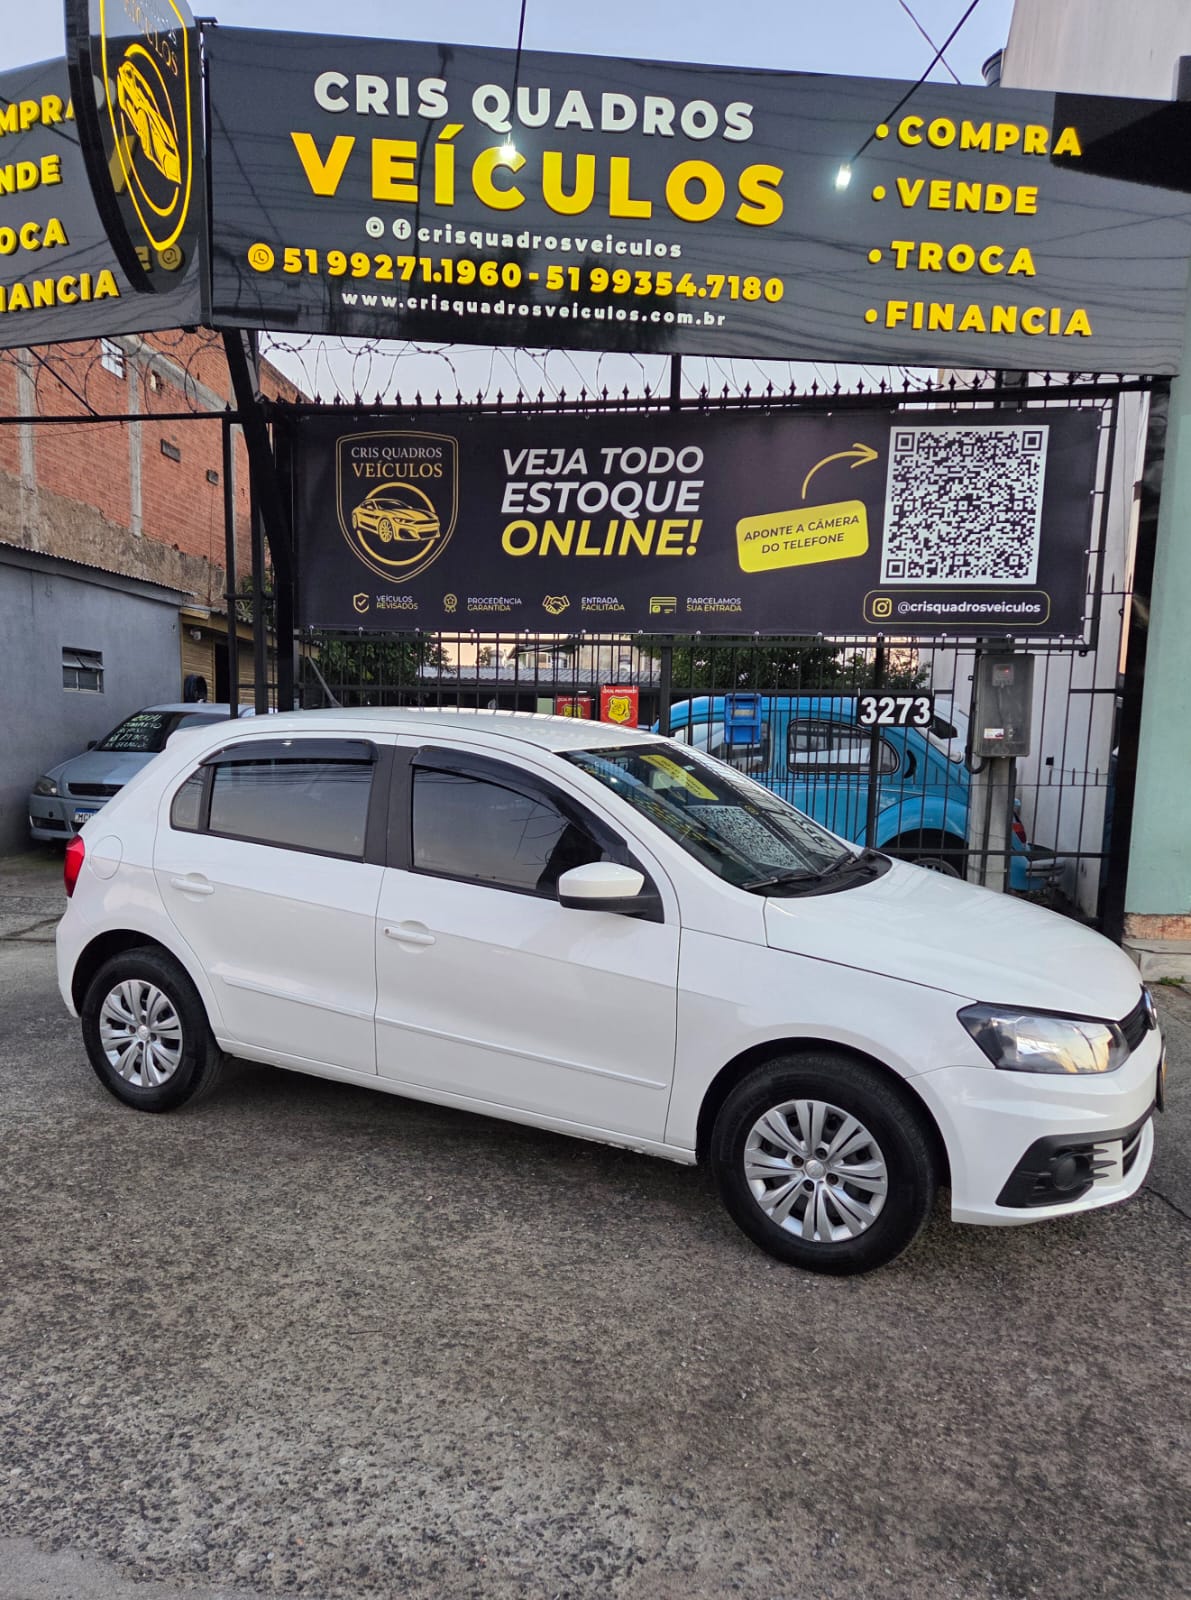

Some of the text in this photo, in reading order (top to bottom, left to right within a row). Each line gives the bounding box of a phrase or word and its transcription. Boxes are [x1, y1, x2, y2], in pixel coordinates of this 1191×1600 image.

[314, 71, 754, 142] CRIS QUADROS
[897, 115, 1082, 157] COMPRA
[290, 123, 784, 226] VEÍCULOS
[896, 177, 1039, 215] VENDE
[417, 223, 682, 258] crisquadrosveiculos
[891, 240, 1037, 276] TROCA
[341, 292, 726, 326] www.crisquadrosveiculos.com.br
[885, 300, 1093, 336] FINANCIA
[351, 447, 442, 460] CRIS QUADROS
[503, 445, 704, 476] VEJA TODO
[352, 460, 443, 478] VEÍCULOS
[501, 480, 705, 519] ESTOQUE
[501, 519, 704, 556] ONLINE!
[744, 515, 860, 542] APONTE A CÂMERA
[761, 532, 844, 554] DO TELEFONE
[376, 594, 413, 603] VEÍCULOS
[376, 602, 418, 610] REVISADOS
[467, 595, 522, 605] PROCEDÊNCIA
[467, 604, 511, 612] GARANTIDA
[581, 596, 619, 604] ENTRADA
[686, 597, 742, 605] PARCELAMOS
[686, 604, 742, 612] SUA ENTRADA
[897, 600, 1041, 615] @crisquadrosveiculos
[860, 696, 931, 724] 3273
